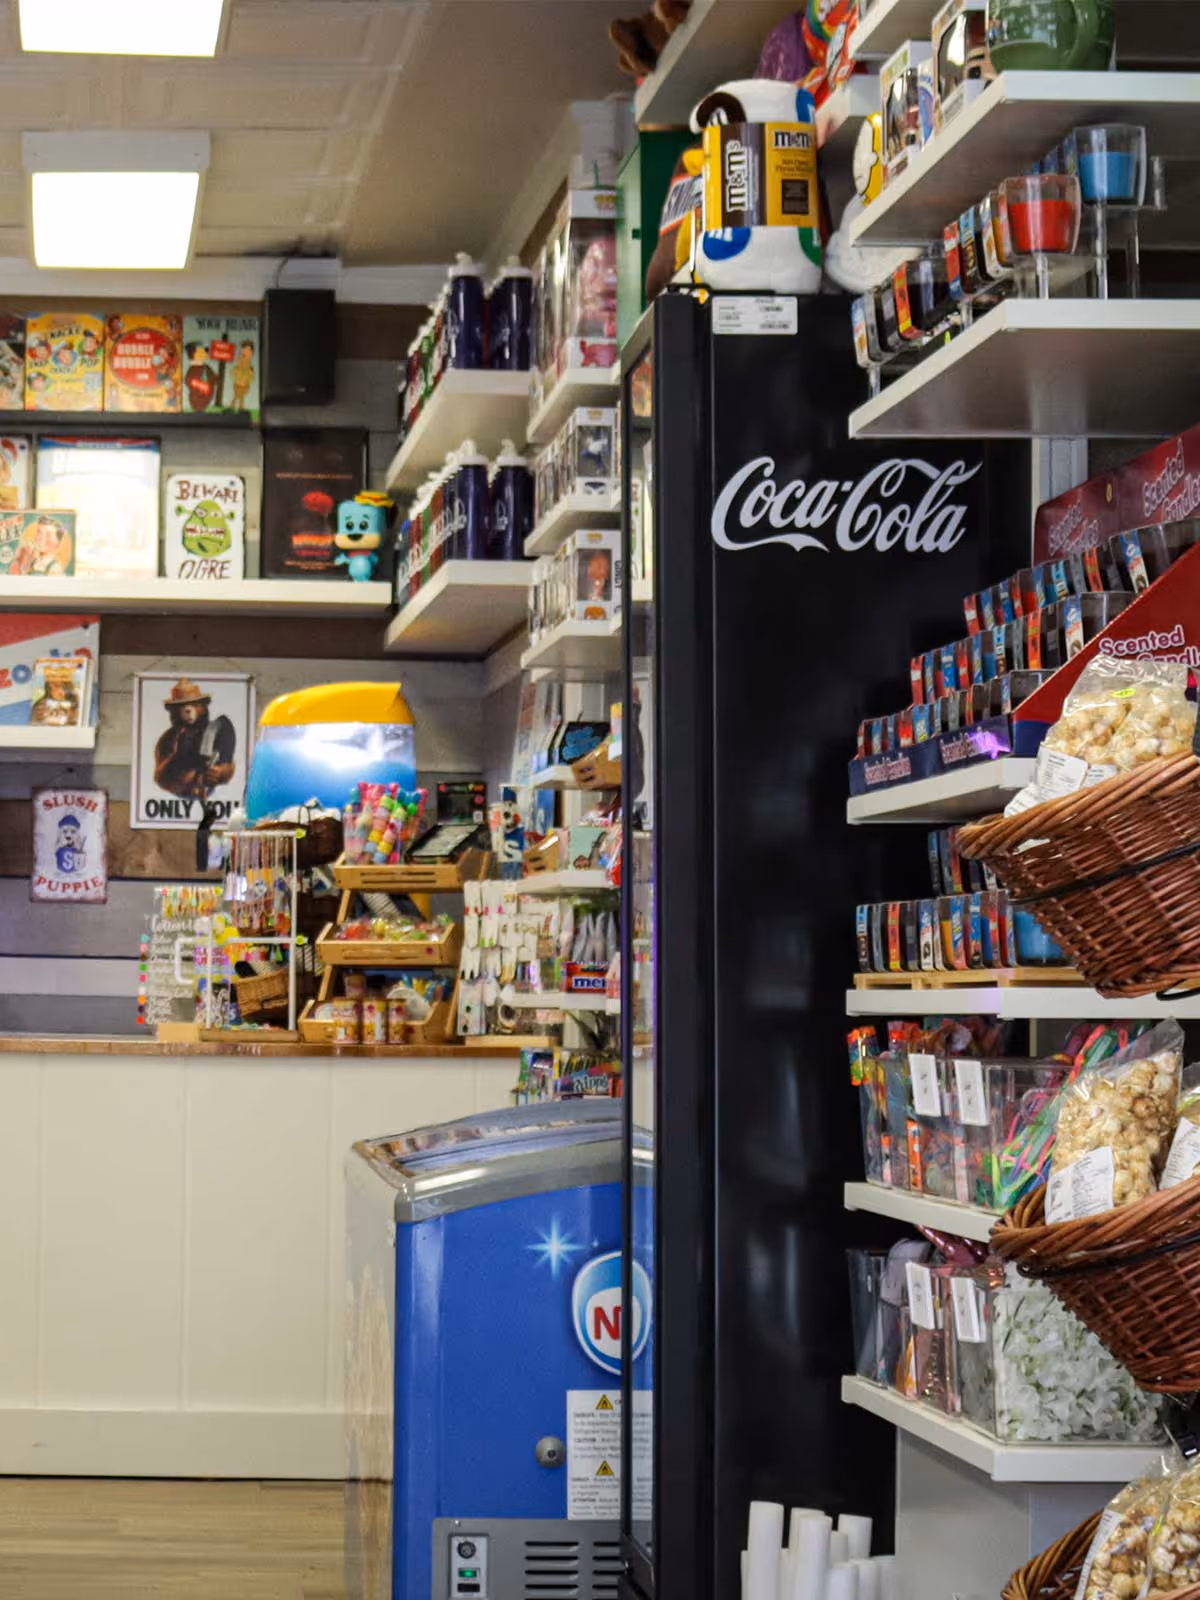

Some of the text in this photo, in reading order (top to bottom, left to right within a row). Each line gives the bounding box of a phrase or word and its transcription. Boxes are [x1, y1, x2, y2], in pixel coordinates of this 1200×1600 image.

[175, 480, 240, 504] BEWARE
[177, 559, 232, 580] OGRE
[1099, 625, 1185, 657] Scented
[1137, 647, 1200, 666] Candl
[42, 792, 98, 813] SLUSH
[144, 799, 193, 818] ONLY
[34, 875, 104, 894] PUPPIE
